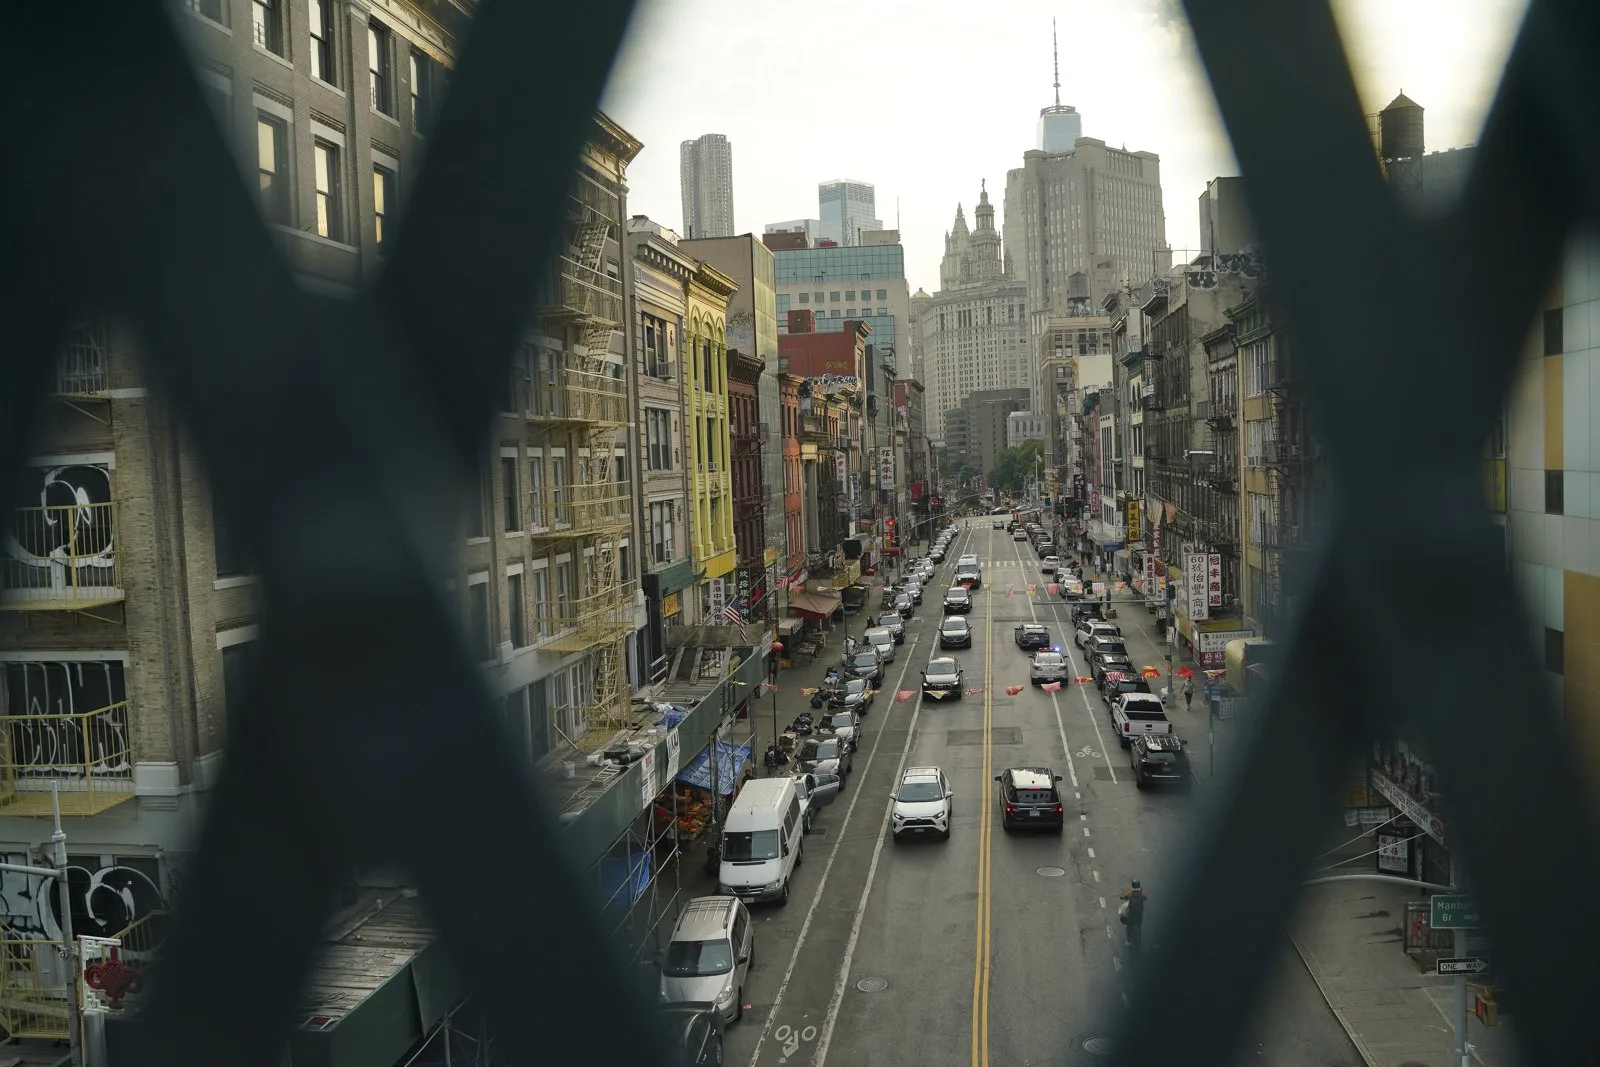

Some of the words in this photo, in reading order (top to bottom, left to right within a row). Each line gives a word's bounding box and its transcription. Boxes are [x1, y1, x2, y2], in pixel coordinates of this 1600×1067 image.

[1442, 913, 1452, 922] Br
[1441, 963, 1458, 971] ONE
[1465, 961, 1482, 970] WAY
